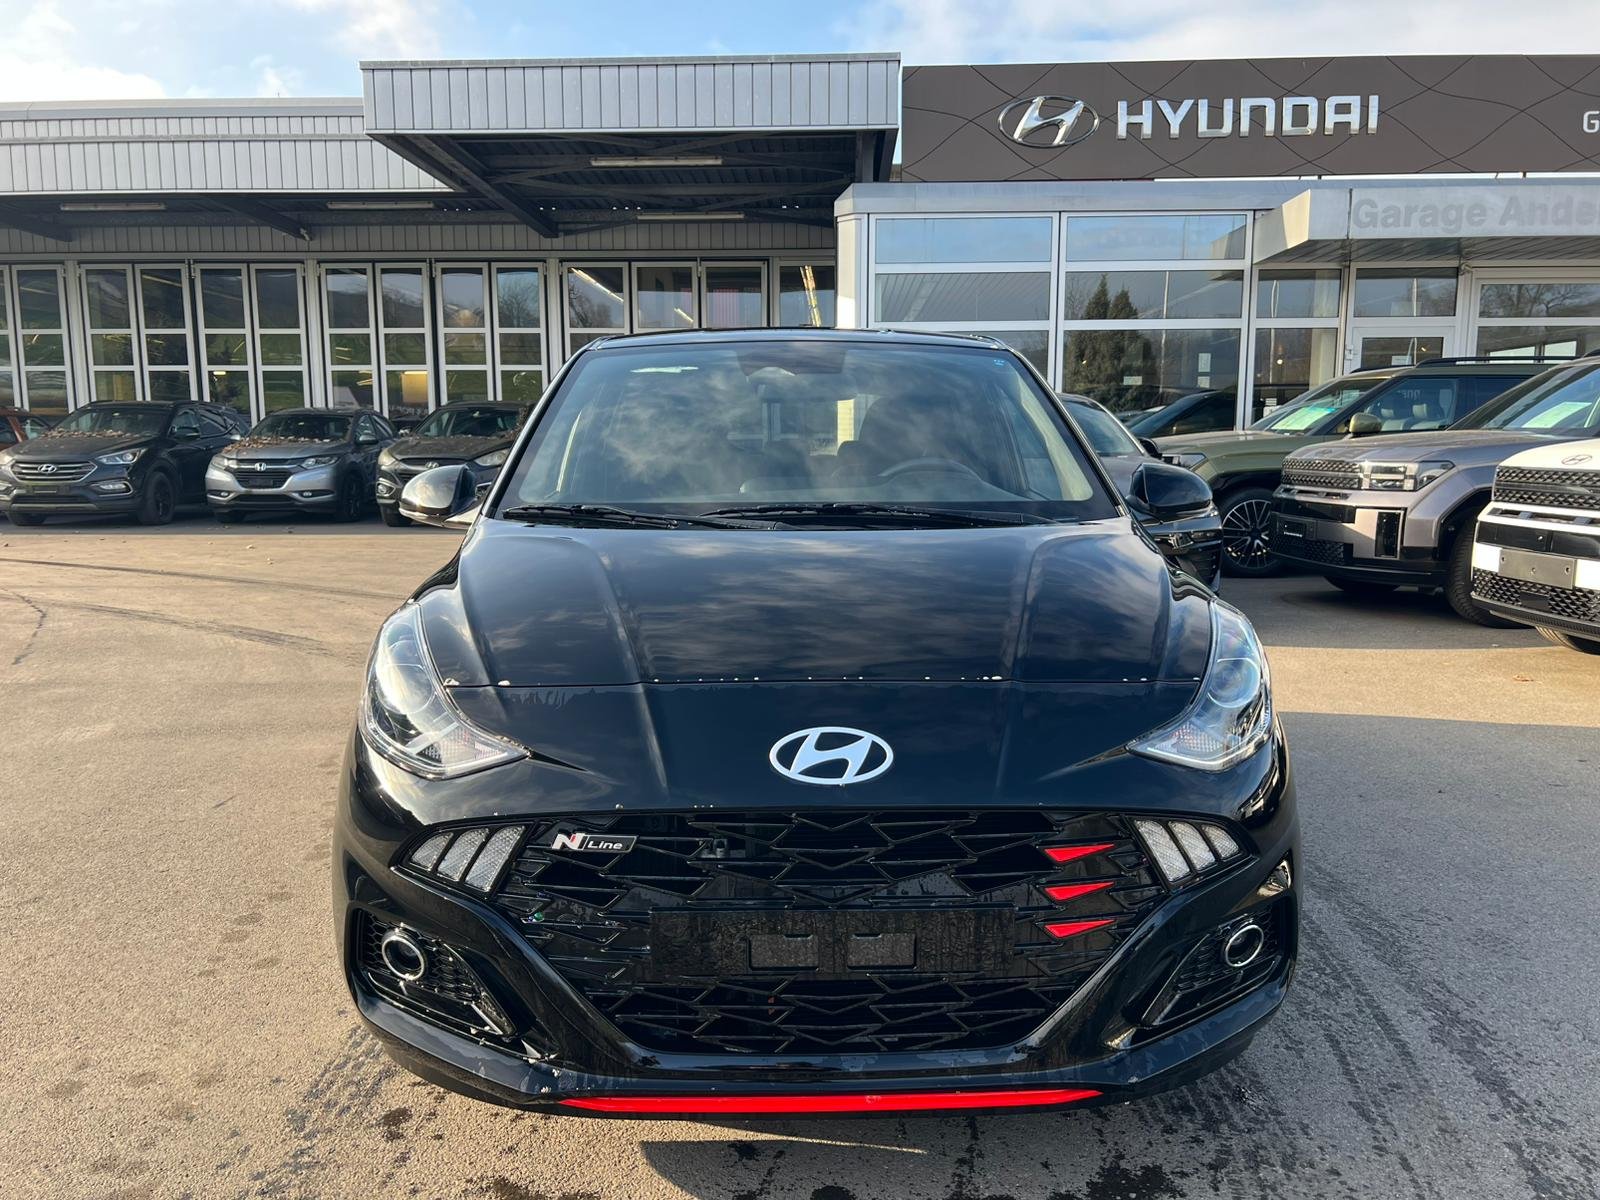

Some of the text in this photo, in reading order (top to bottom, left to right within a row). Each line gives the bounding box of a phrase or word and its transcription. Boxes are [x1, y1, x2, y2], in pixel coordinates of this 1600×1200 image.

[1117, 95, 1379, 140] HYUNDAI
[1352, 194, 1600, 234] Garage Ande
[587, 840, 623, 850] Line
